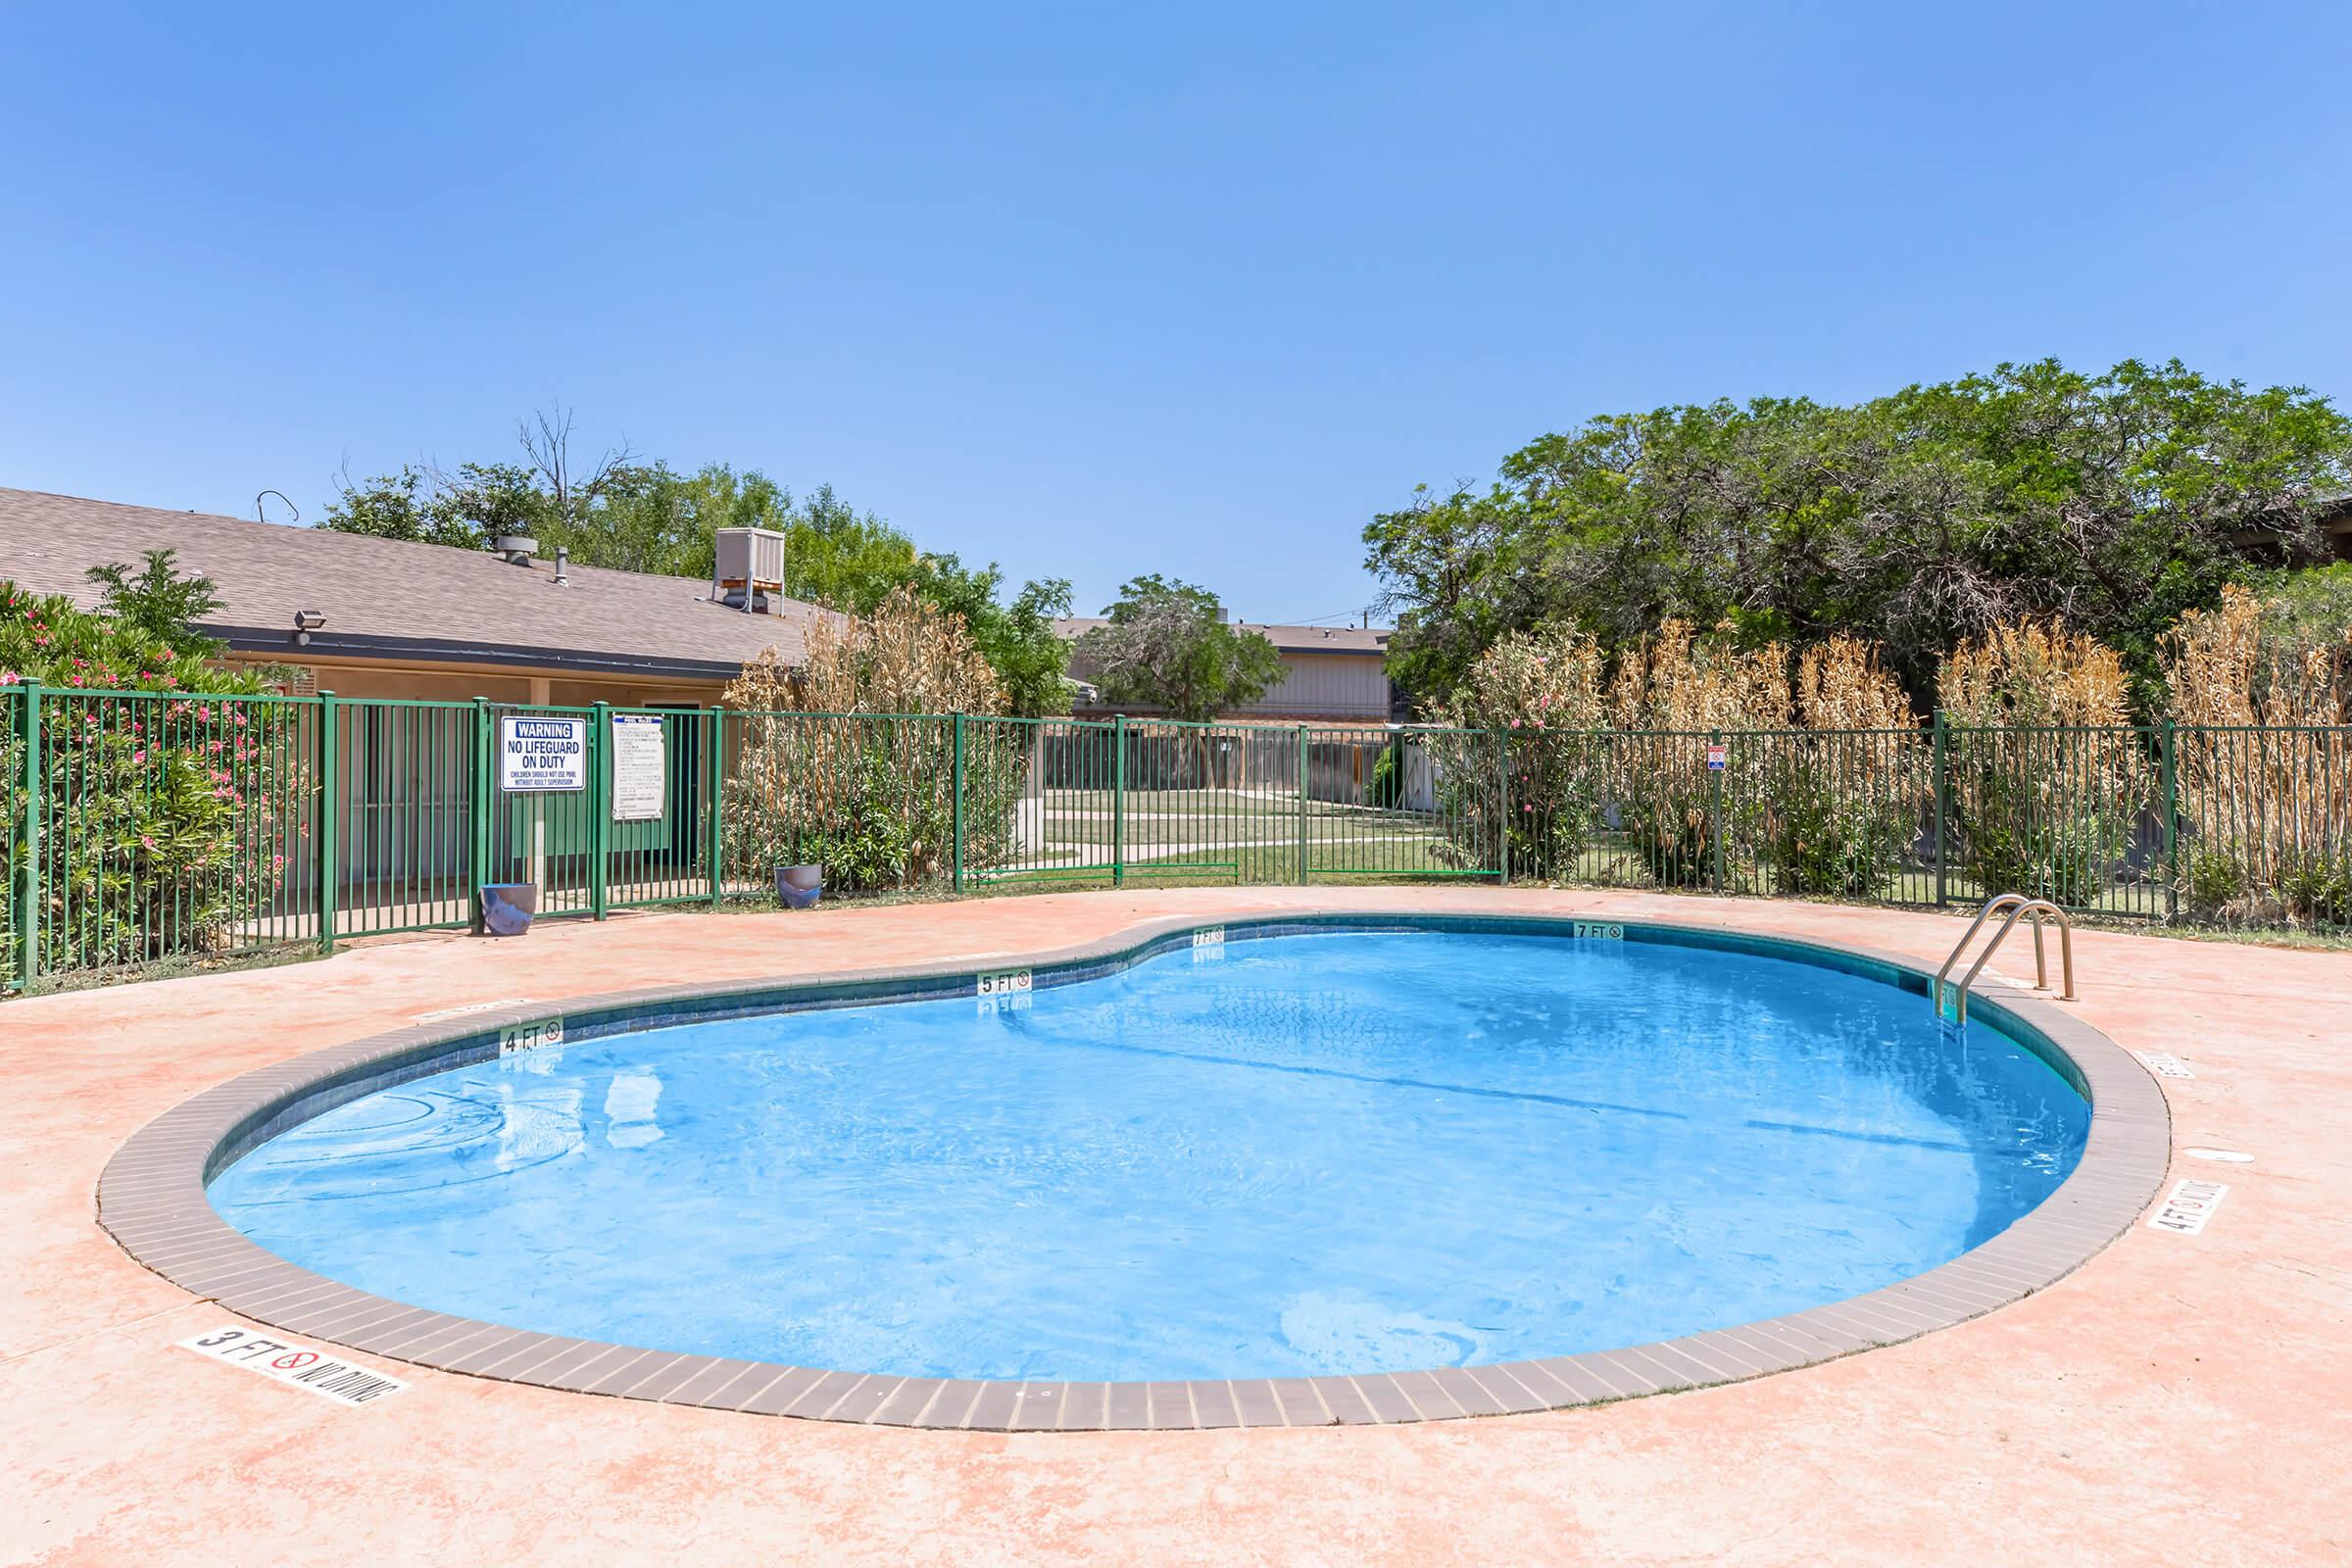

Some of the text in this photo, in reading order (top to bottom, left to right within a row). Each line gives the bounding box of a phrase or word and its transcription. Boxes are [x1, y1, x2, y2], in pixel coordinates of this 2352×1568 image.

[517, 722, 570, 737] WARNING
[508, 740, 579, 754] NO LIFEGUARD
[522, 755, 565, 769] ON DUTY
[1196, 929, 1213, 945] 7 FT
[1578, 924, 1605, 939] 7 FT
[983, 973, 1013, 993] 5 FT
[506, 1026, 540, 1052] 4 FT
[2162, 1207, 2204, 1223] FT
[2157, 1220, 2194, 1230] 4
[197, 1331, 244, 1347] 3
[220, 1340, 288, 1361] FT
[291, 1362, 346, 1382] NO
[316, 1370, 399, 1402] DIVING
